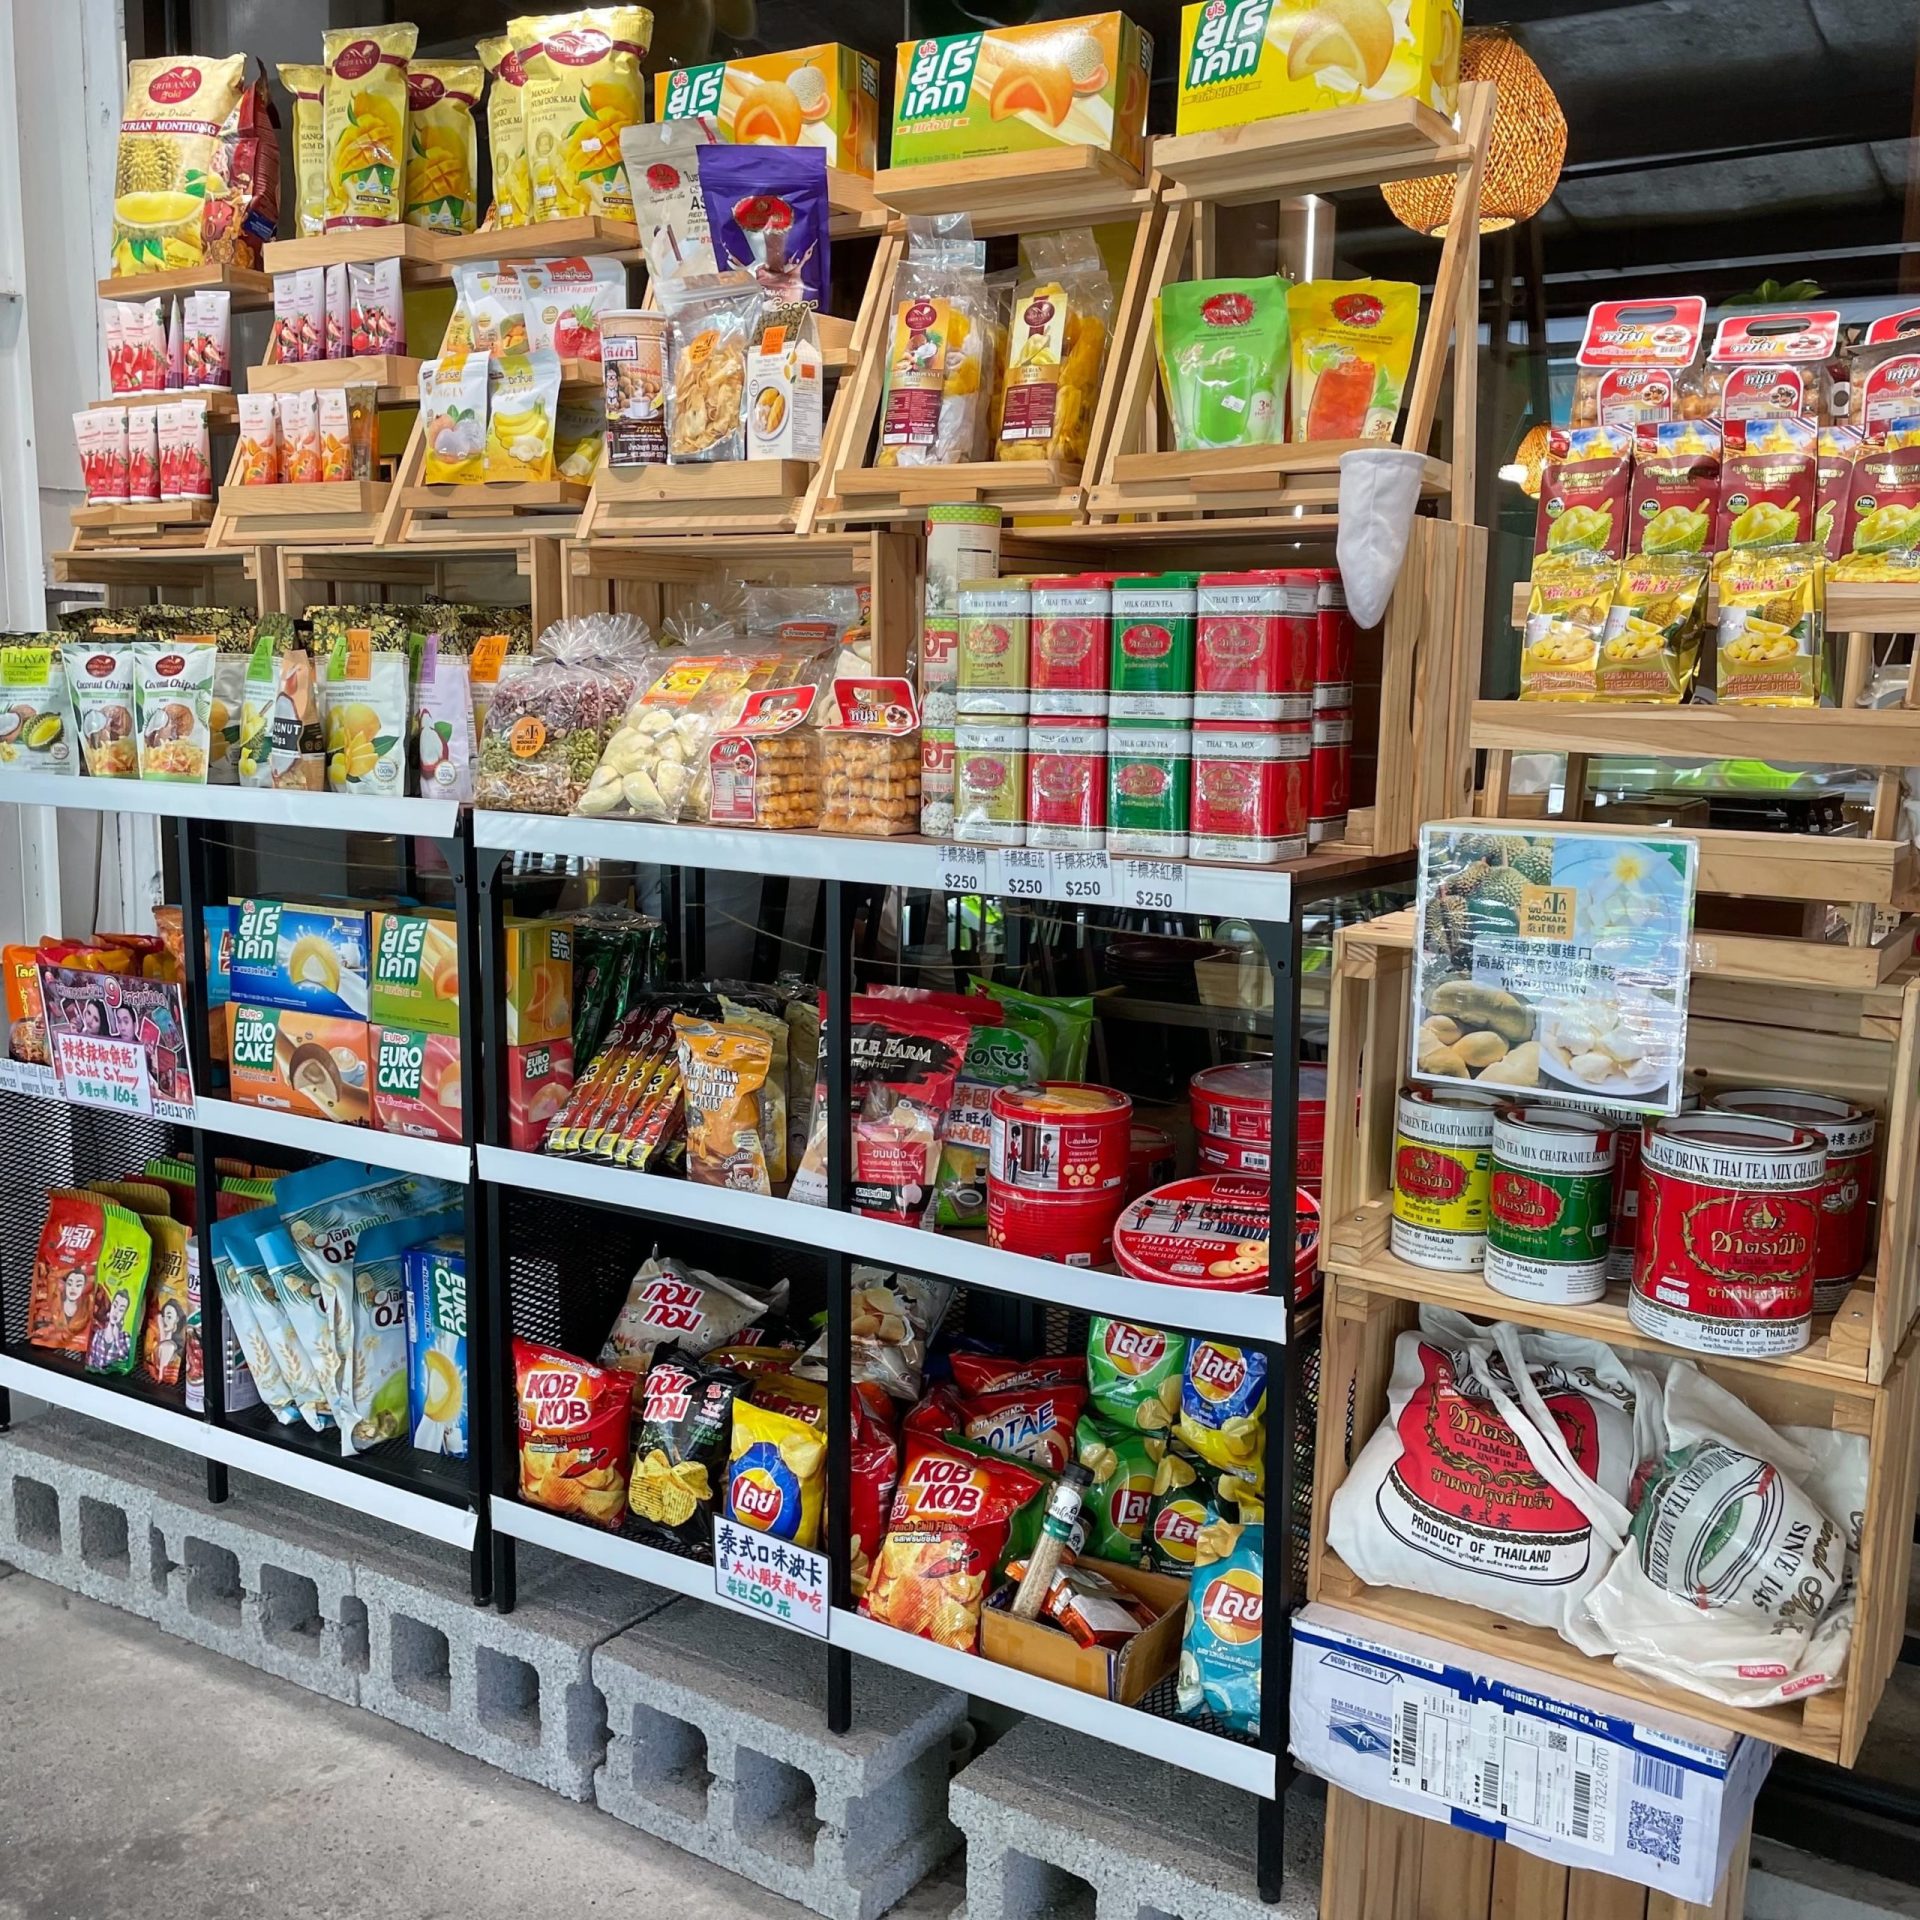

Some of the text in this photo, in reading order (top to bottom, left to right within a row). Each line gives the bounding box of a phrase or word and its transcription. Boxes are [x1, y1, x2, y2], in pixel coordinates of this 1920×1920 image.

[911, 35, 982, 92] ยูโร่
[1191, 41, 1257, 85] เค้ก
[152, 80, 197, 91] SRIWANNA
[905, 78, 966, 116] เค้ก
[156, 121, 216, 135] MONTHONG
[772, 297, 819, 311] Cocoa
[4, 652, 47, 665] THAYA
[1604, 680, 1640, 689] FREEZE
[945, 873, 978, 890] $250
[1008, 878, 1043, 894] $250
[1065, 881, 1101, 896] $250
[1136, 890, 1173, 908] $250
[1527, 914, 1568, 924] MOOKATA
[1528, 907, 1542, 915] WU
[239, 905, 281, 942] ยูโร่
[237, 936, 274, 960] เค้ก
[381, 922, 426, 960] ยูโร่
[1500, 939, 1592, 962] 泰國空運進口
[378, 954, 417, 979] เค้ก
[103, 975, 122, 1008] 9
[238, 1009, 264, 1021] EURO
[235, 1022, 276, 1043] EURO
[384, 1033, 409, 1044] EURO
[234, 1042, 274, 1063] CAKE
[379, 1046, 423, 1068] EURO
[526, 1053, 550, 1069] EURO
[883, 1038, 932, 1064] FARM
[378, 1068, 420, 1089] CAKE
[525, 1065, 550, 1079] CAKE
[955, 1085, 991, 1110] 泰國
[1420, 1117, 1434, 1132] TEA
[1434, 1118, 1484, 1138] CHATRAMUE
[872, 1147, 907, 1160] ขนมปัง
[1520, 1145, 1537, 1160] MIX
[1539, 1148, 1592, 1164] CHATRAMUE
[1675, 1150, 1792, 1180] DRINK THAI TEA MIX
[1216, 1186, 1263, 1196] IMPERIAL
[1414, 1231, 1421, 1240] OF
[1424, 1234, 1454, 1245] THAILAND
[323, 1239, 356, 1264] OA
[1506, 1260, 1548, 1275] OF THAILAND
[434, 1268, 456, 1332] CAKE
[375, 1303, 406, 1327] OA
[1701, 1323, 1800, 1338] PRODUCT OF THAILAND
[524, 1372, 580, 1400] KOB
[537, 1398, 591, 1426] KOB
[999, 1403, 1026, 1420] SNACK
[560, 1431, 591, 1445] Flavour
[1454, 1433, 1513, 1459] ChaTraMue
[913, 1458, 975, 1484] KOB
[1476, 1452, 1519, 1469] SINCE 1945
[918, 1484, 983, 1514] KOB
[1662, 1490, 1691, 1520] TEA
[888, 1521, 914, 1532] French
[1411, 1513, 1463, 1548] PRODUCT
[1470, 1541, 1486, 1554] OF
[1494, 1545, 1551, 1563] THAILAND
[717, 1524, 822, 1587] 泰式口味波卡
[1752, 1519, 1812, 1614] SINCE 1945
[1502, 1687, 1537, 1709] LOGISTICS
[1537, 1700, 1544, 1710] &
[1545, 1702, 1578, 1721] SHIPPING
[1595, 1718, 1610, 1731] LTD.
